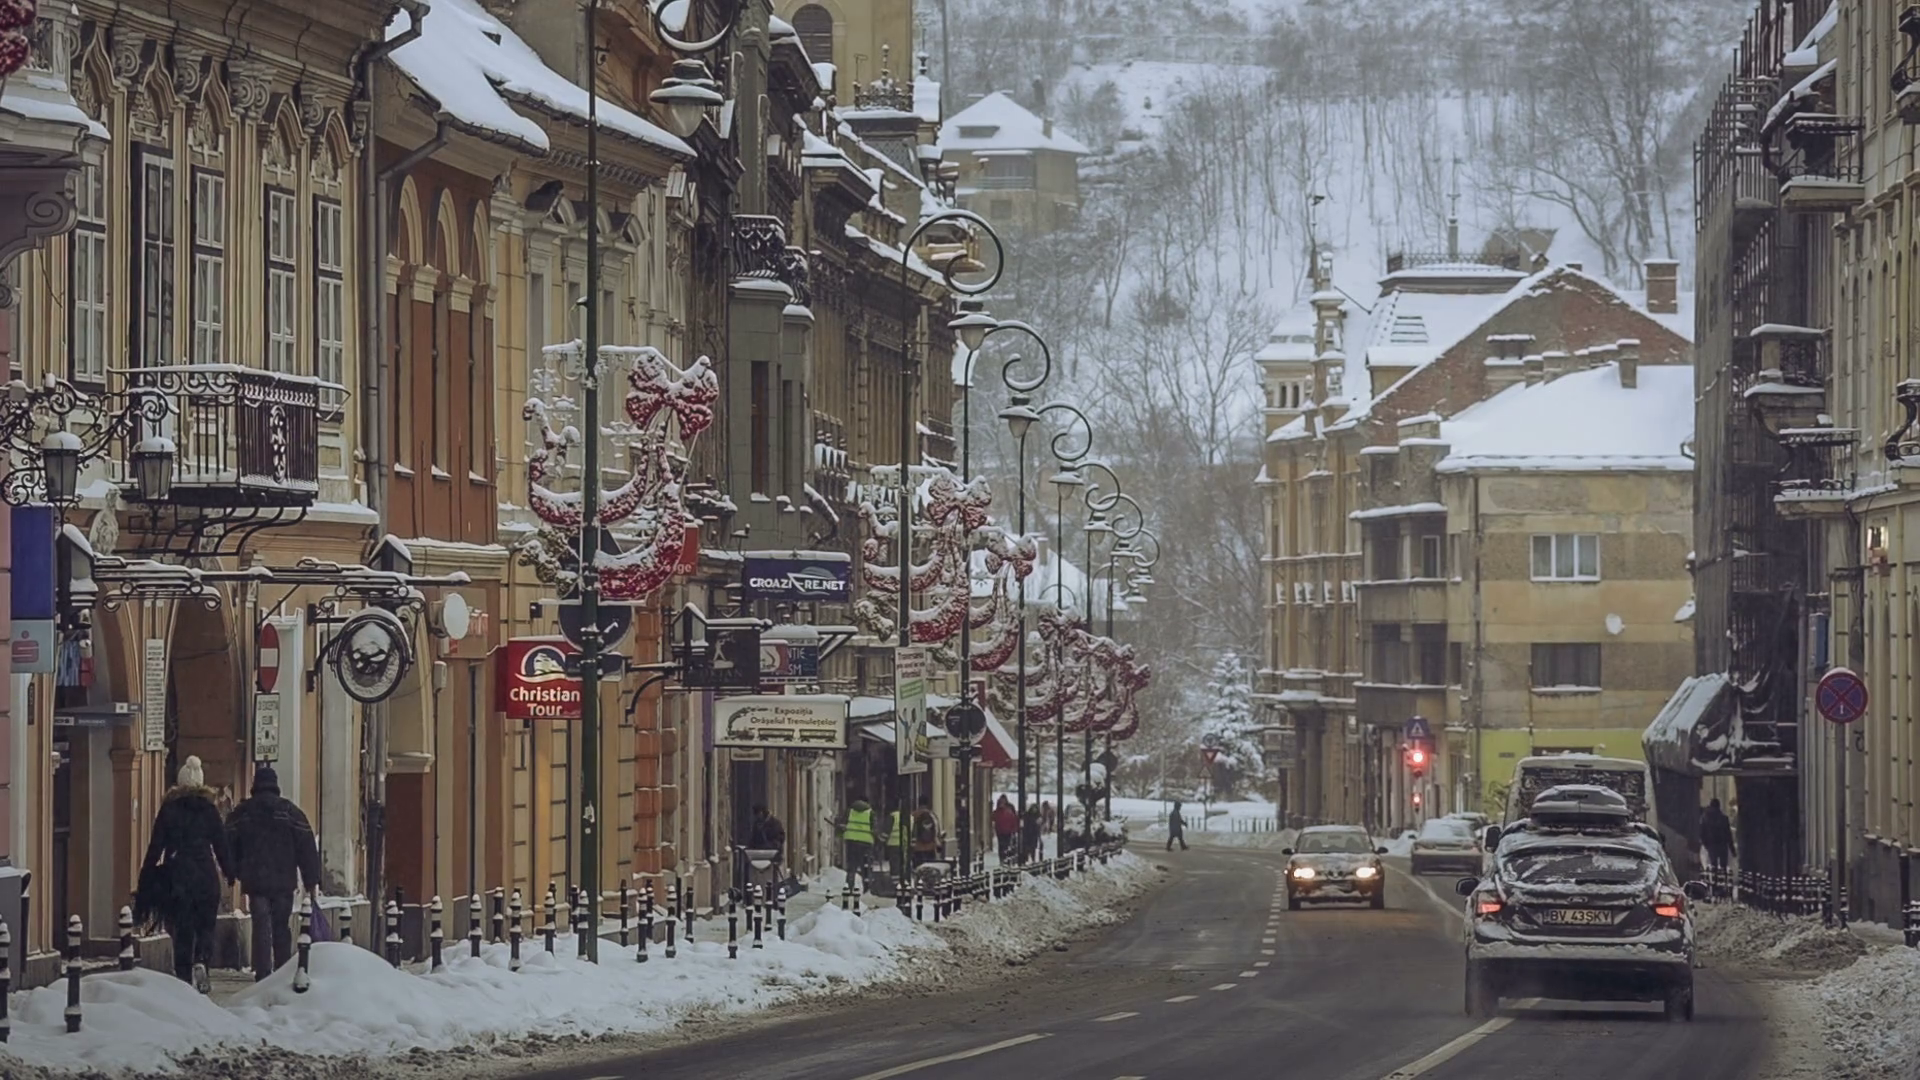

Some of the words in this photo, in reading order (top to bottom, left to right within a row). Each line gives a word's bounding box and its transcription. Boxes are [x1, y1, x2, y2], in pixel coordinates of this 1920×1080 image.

[510, 686, 580, 702] Christian
[527, 702, 563, 716] Tour
[1551, 910, 1567, 921] BV
